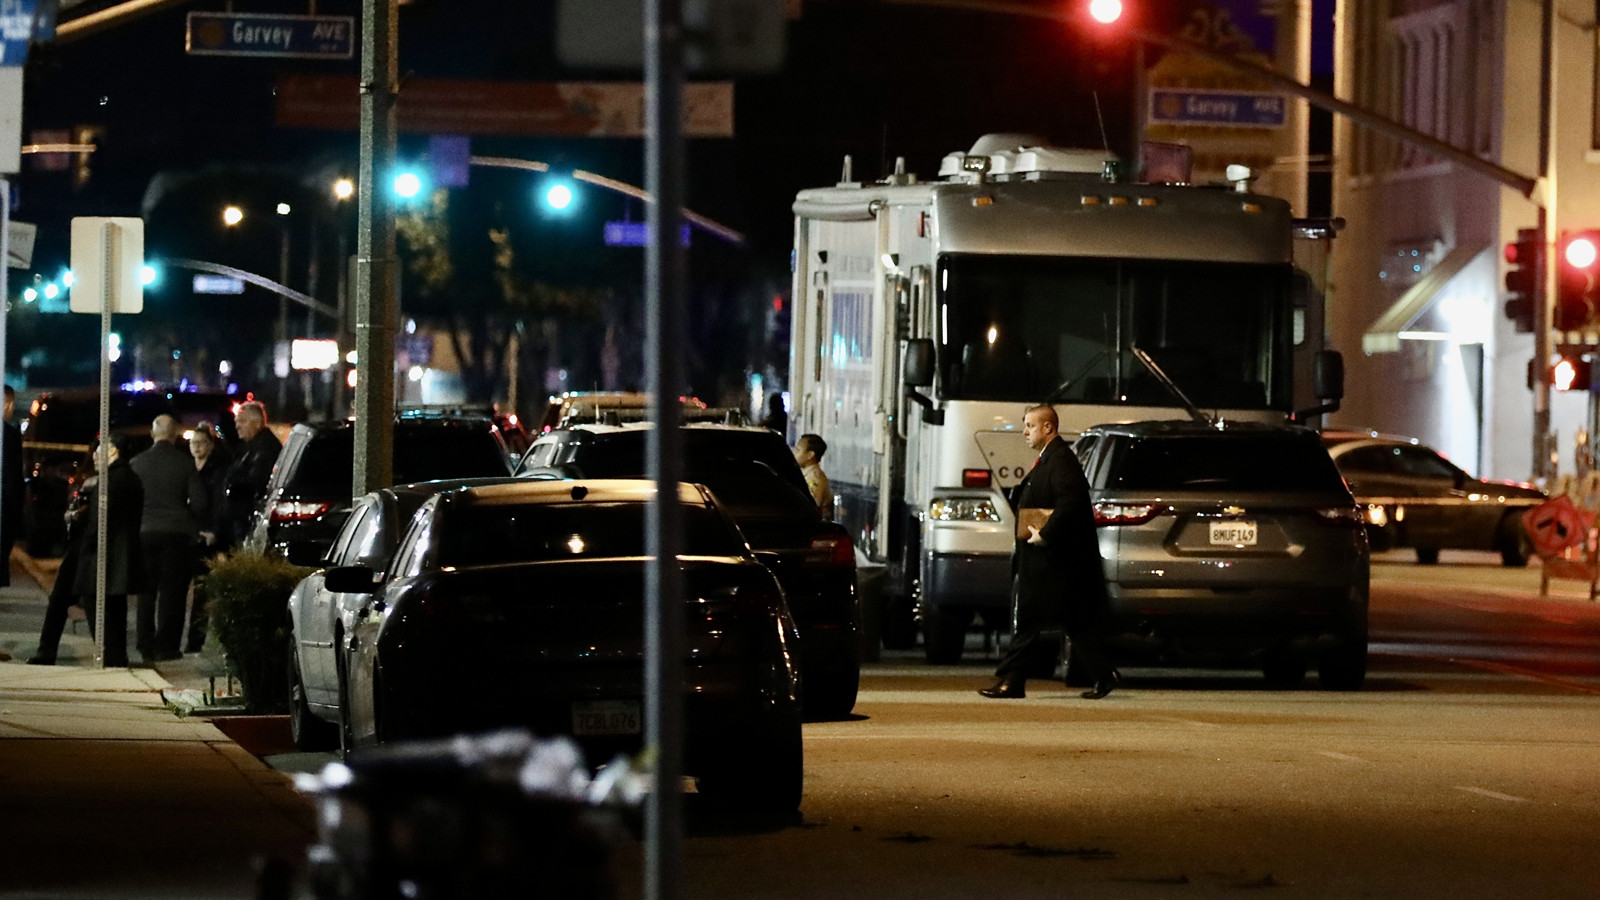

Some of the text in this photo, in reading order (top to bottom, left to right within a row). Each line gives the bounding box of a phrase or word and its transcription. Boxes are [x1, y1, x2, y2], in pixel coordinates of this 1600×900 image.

[232, 20, 293, 50] Garvey
[312, 22, 345, 41] AVE
[1186, 95, 1281, 120] Garvey AVE
[1213, 529, 1254, 541] 8MUF149
[576, 712, 636, 730] 7CBL076
